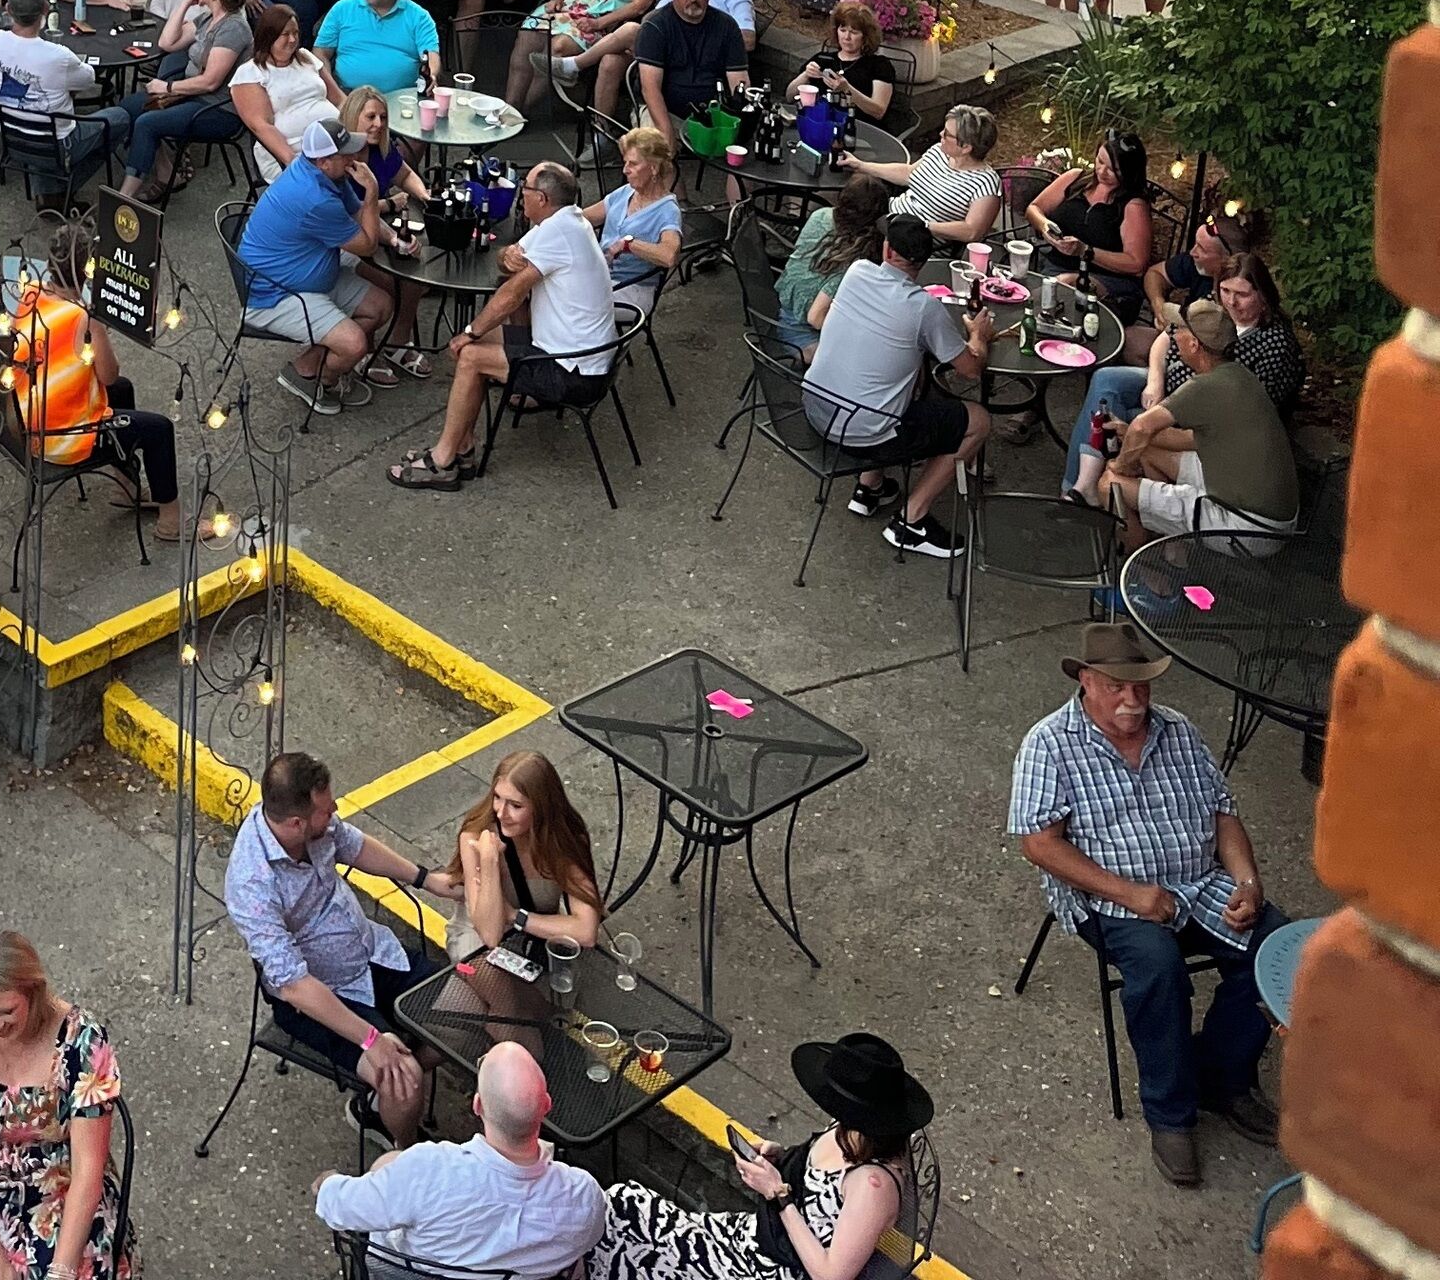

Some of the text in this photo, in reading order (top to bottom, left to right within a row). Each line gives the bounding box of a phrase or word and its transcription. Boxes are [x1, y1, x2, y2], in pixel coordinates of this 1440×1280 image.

[113, 247, 137, 270] ALL
[99, 255, 151, 291] BEVERAGES
[105, 276, 141, 301] must be
[100, 288, 145, 318] purchased
[106, 304, 137, 326] on site
